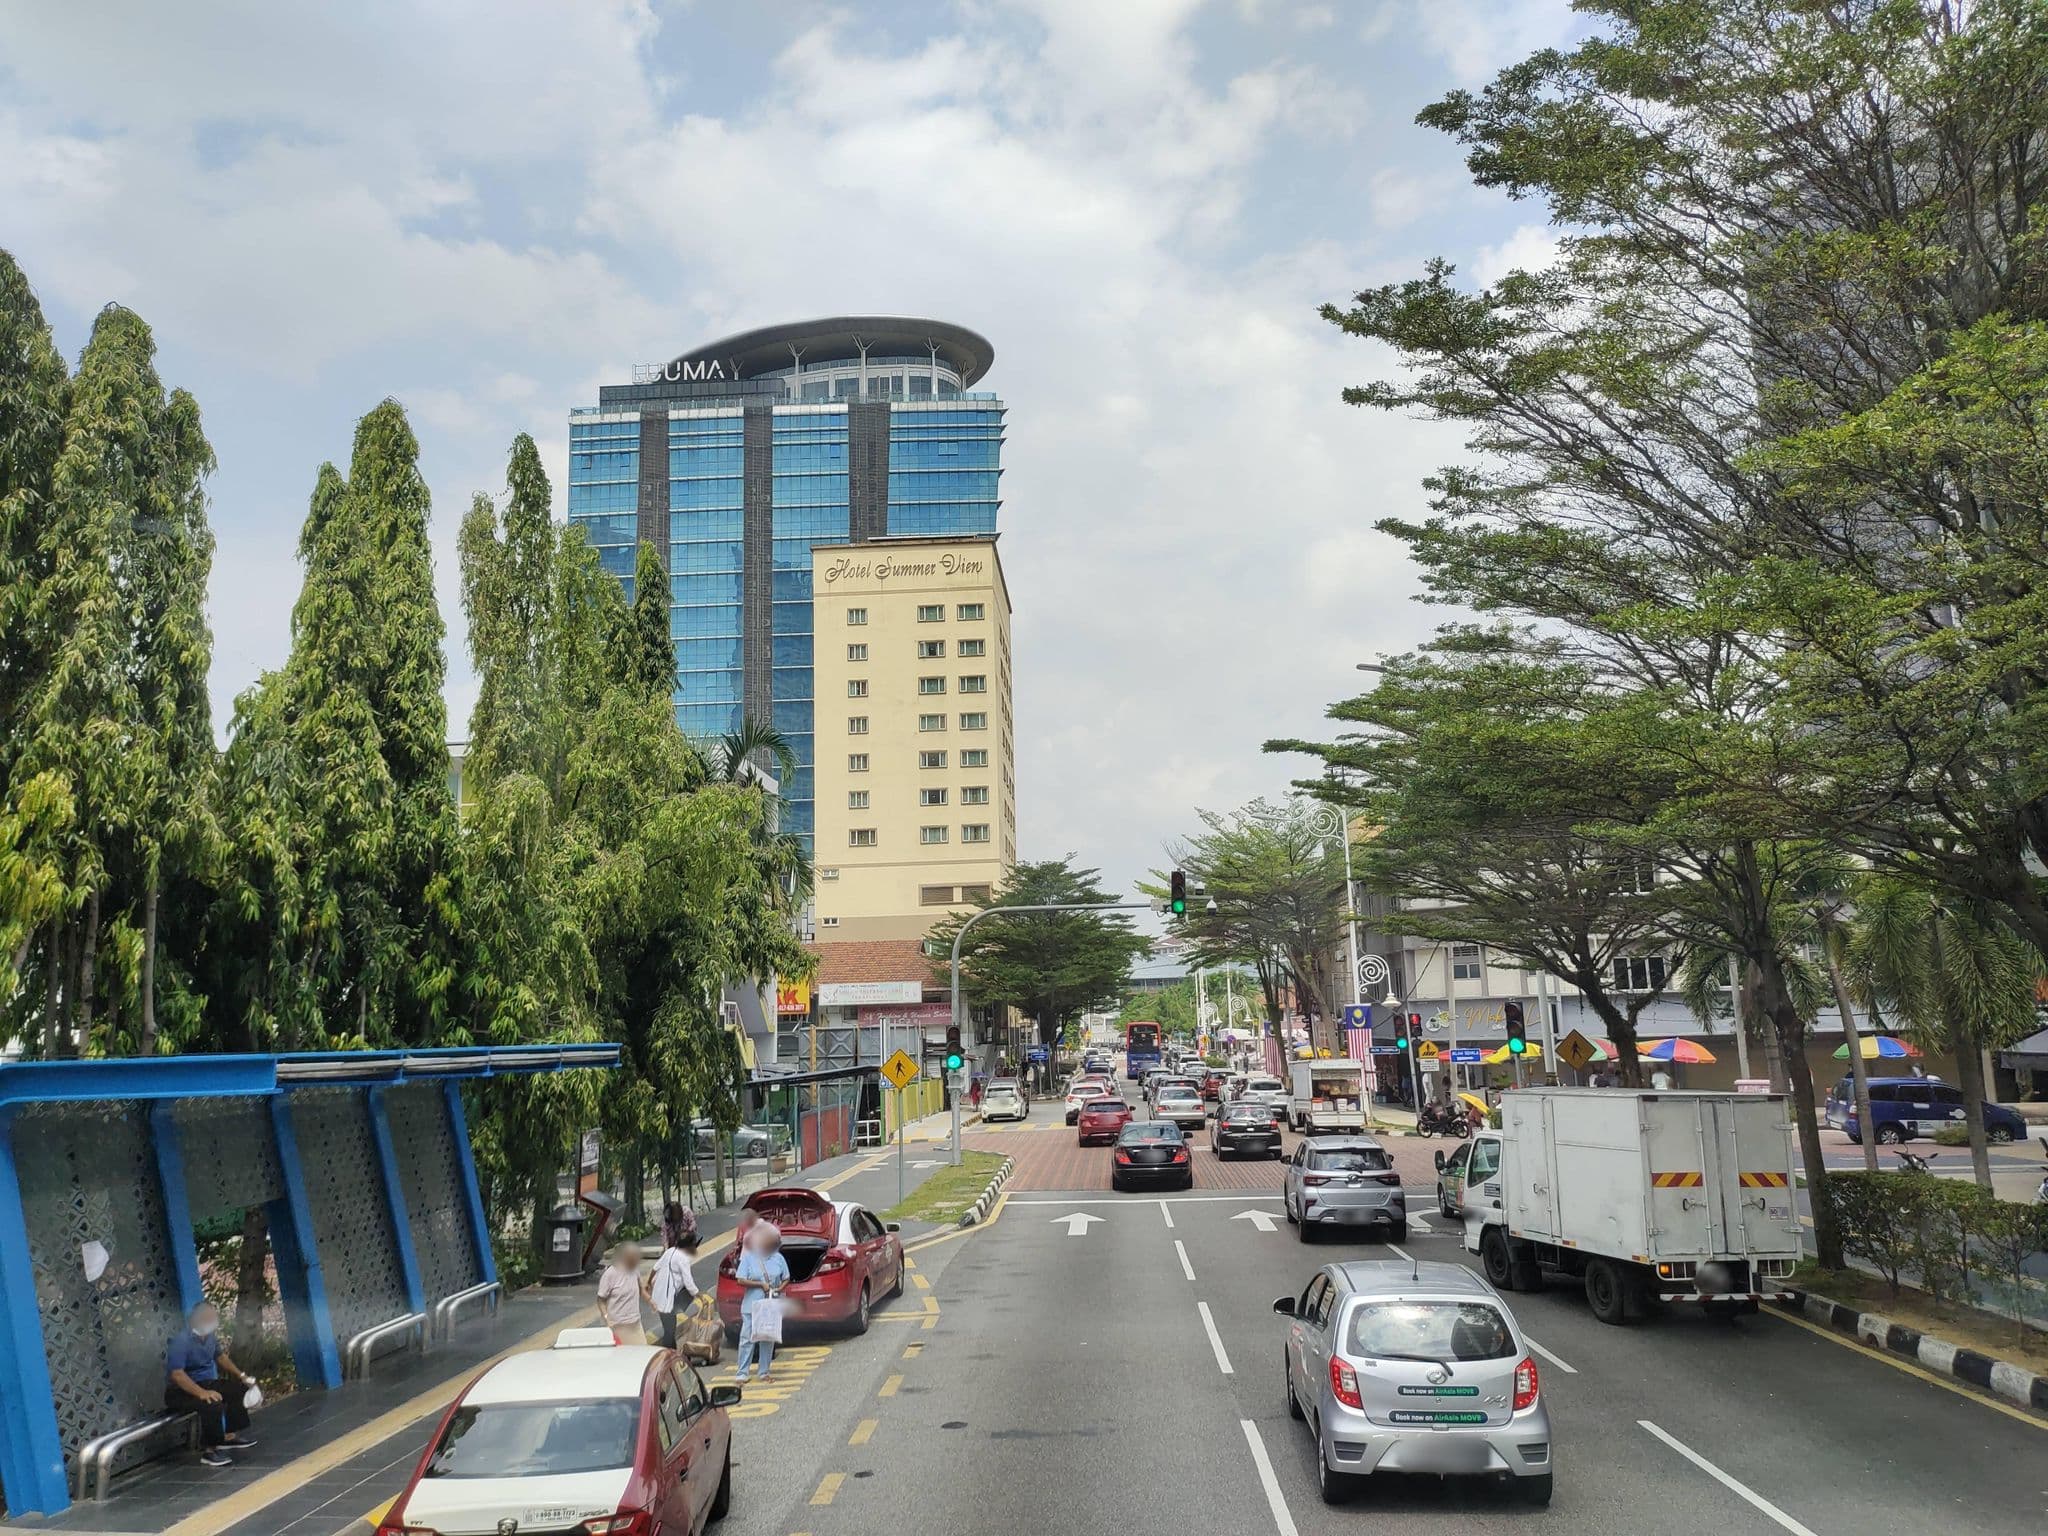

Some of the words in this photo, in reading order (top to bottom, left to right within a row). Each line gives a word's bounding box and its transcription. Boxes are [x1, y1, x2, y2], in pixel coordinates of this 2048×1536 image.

[824, 558, 872, 584] Hotel
[874, 555, 937, 580] Summer
[938, 553, 983, 576] View
[1434, 1386, 1456, 1394] AirAsia
[1395, 1413, 1410, 1421] Book
[1434, 1413, 1459, 1421] AirAsia
[1460, 1413, 1481, 1421] MOVE
